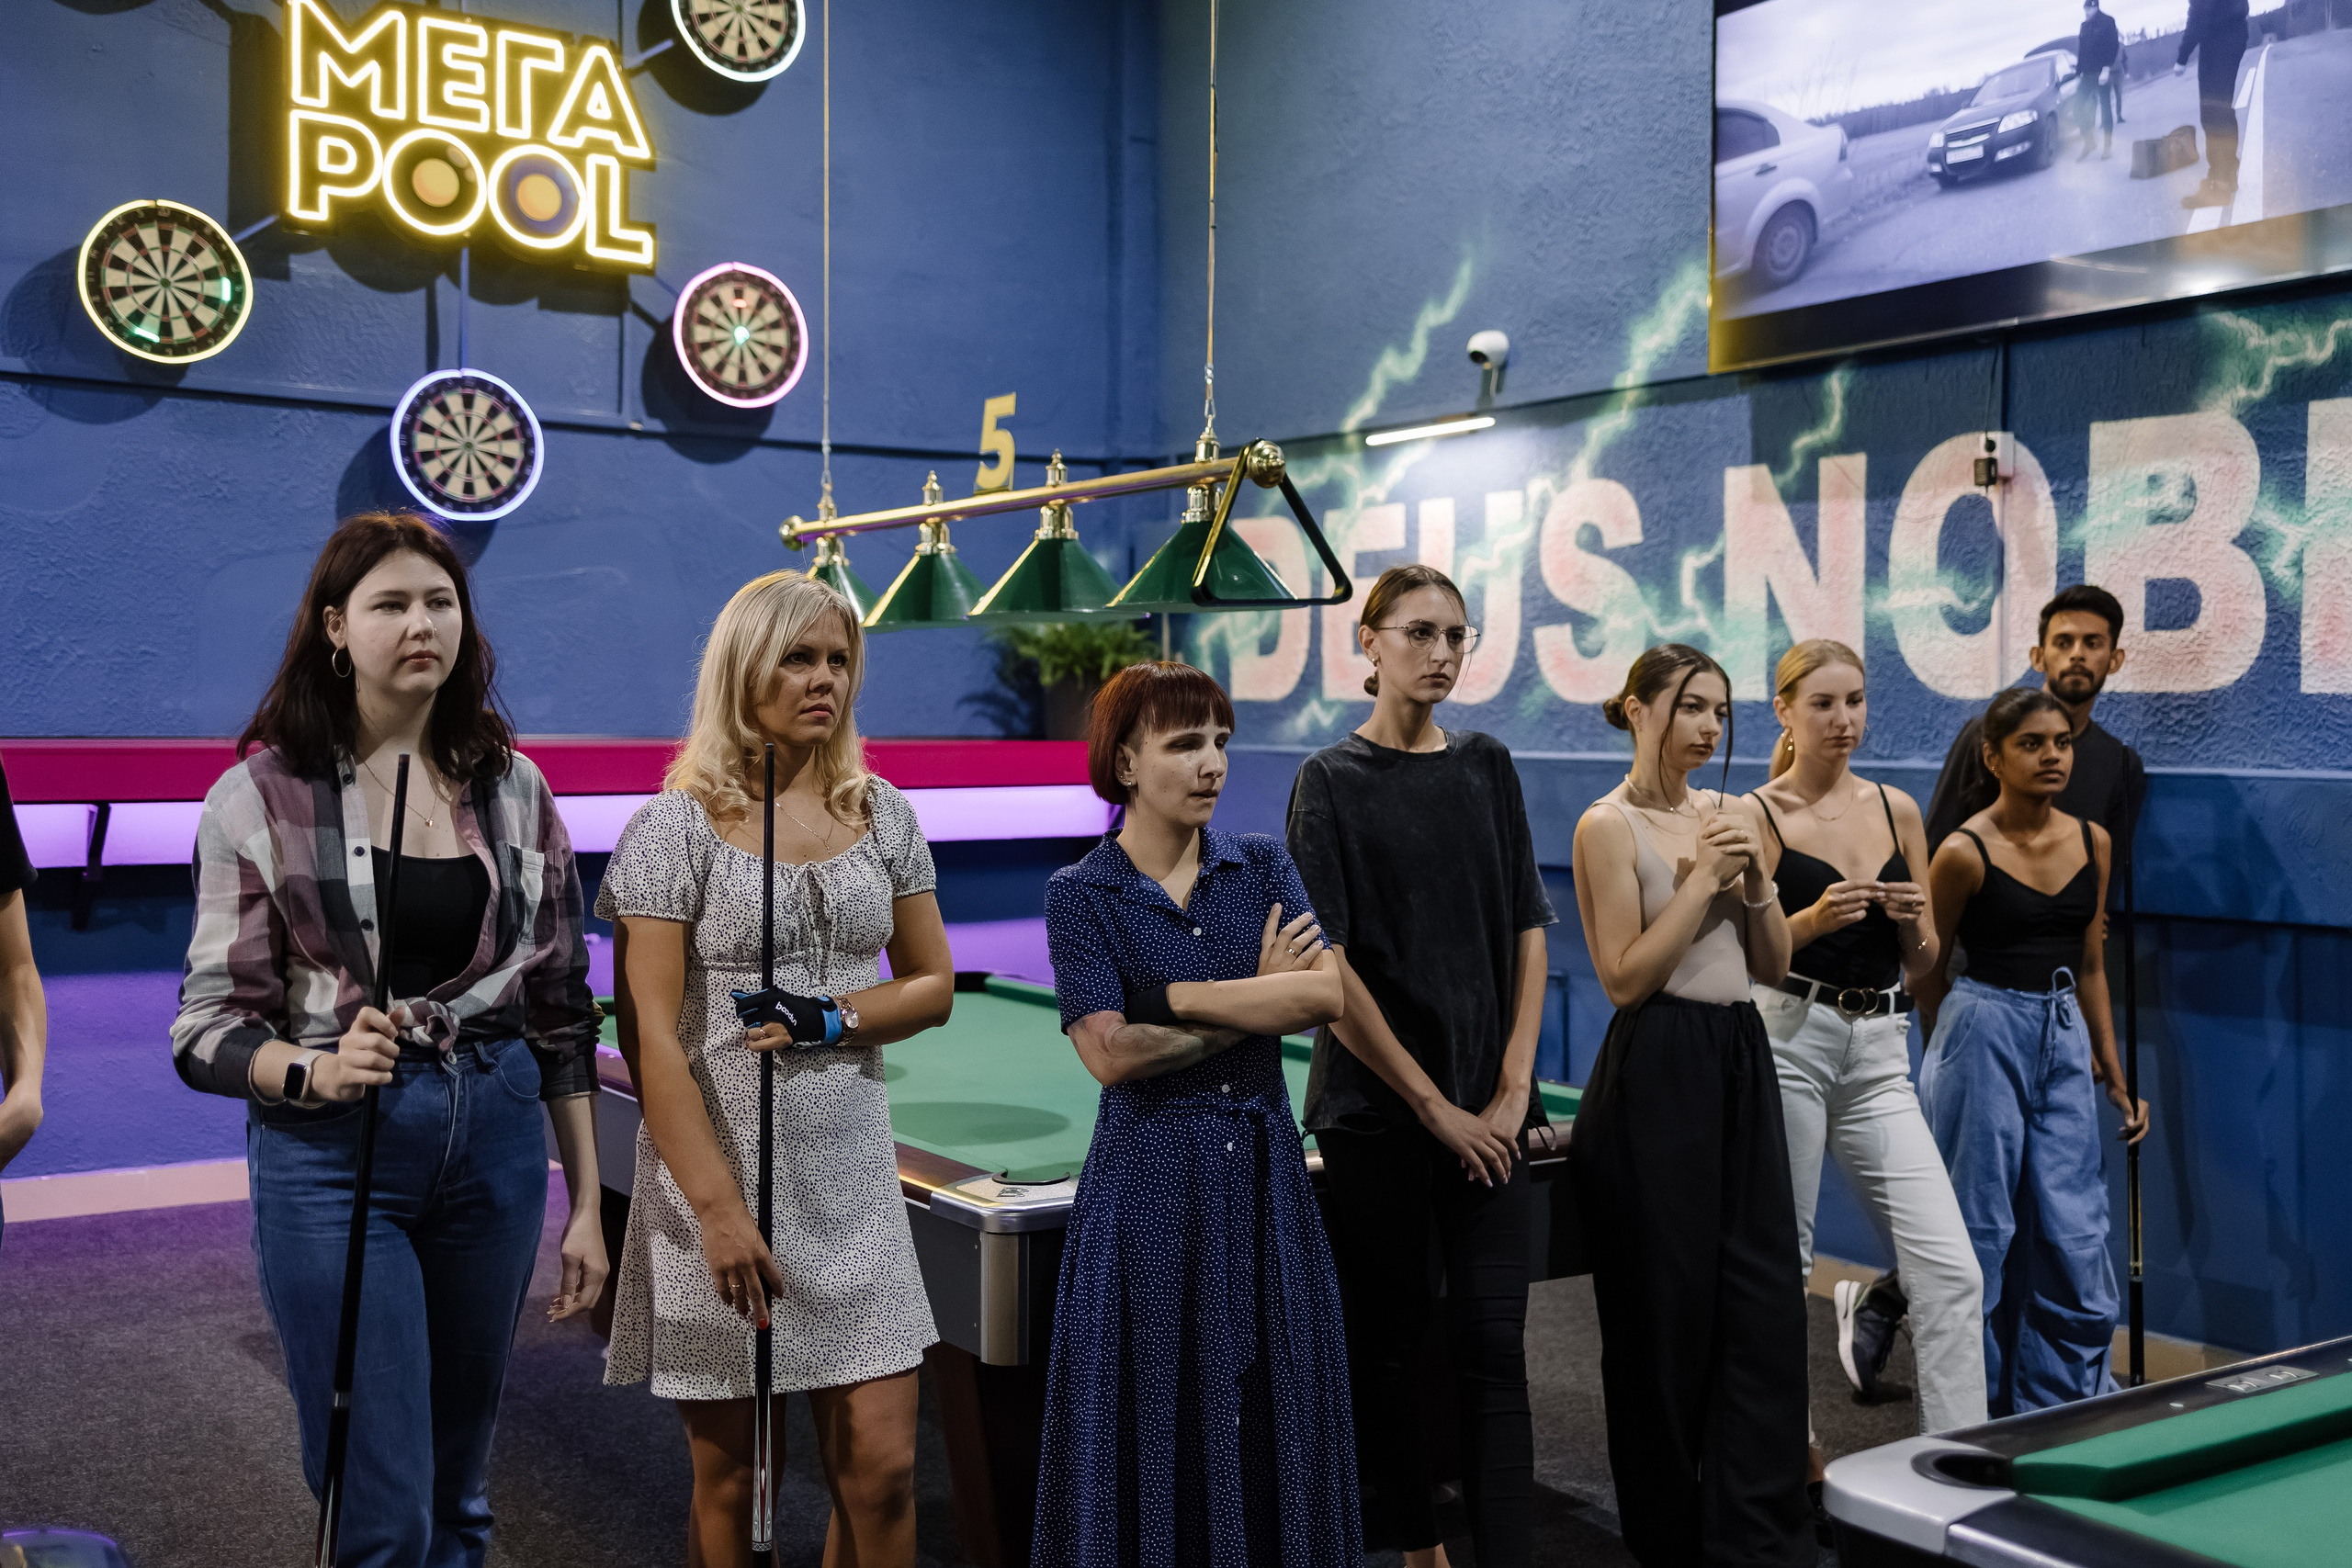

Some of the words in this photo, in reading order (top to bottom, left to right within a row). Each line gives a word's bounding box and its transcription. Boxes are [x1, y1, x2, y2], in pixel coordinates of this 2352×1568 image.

[291, 0, 650, 158] МЕГА
[289, 109, 653, 265] POOL
[976, 392, 1016, 490] 5
[1229, 477, 1649, 705] DEUS
